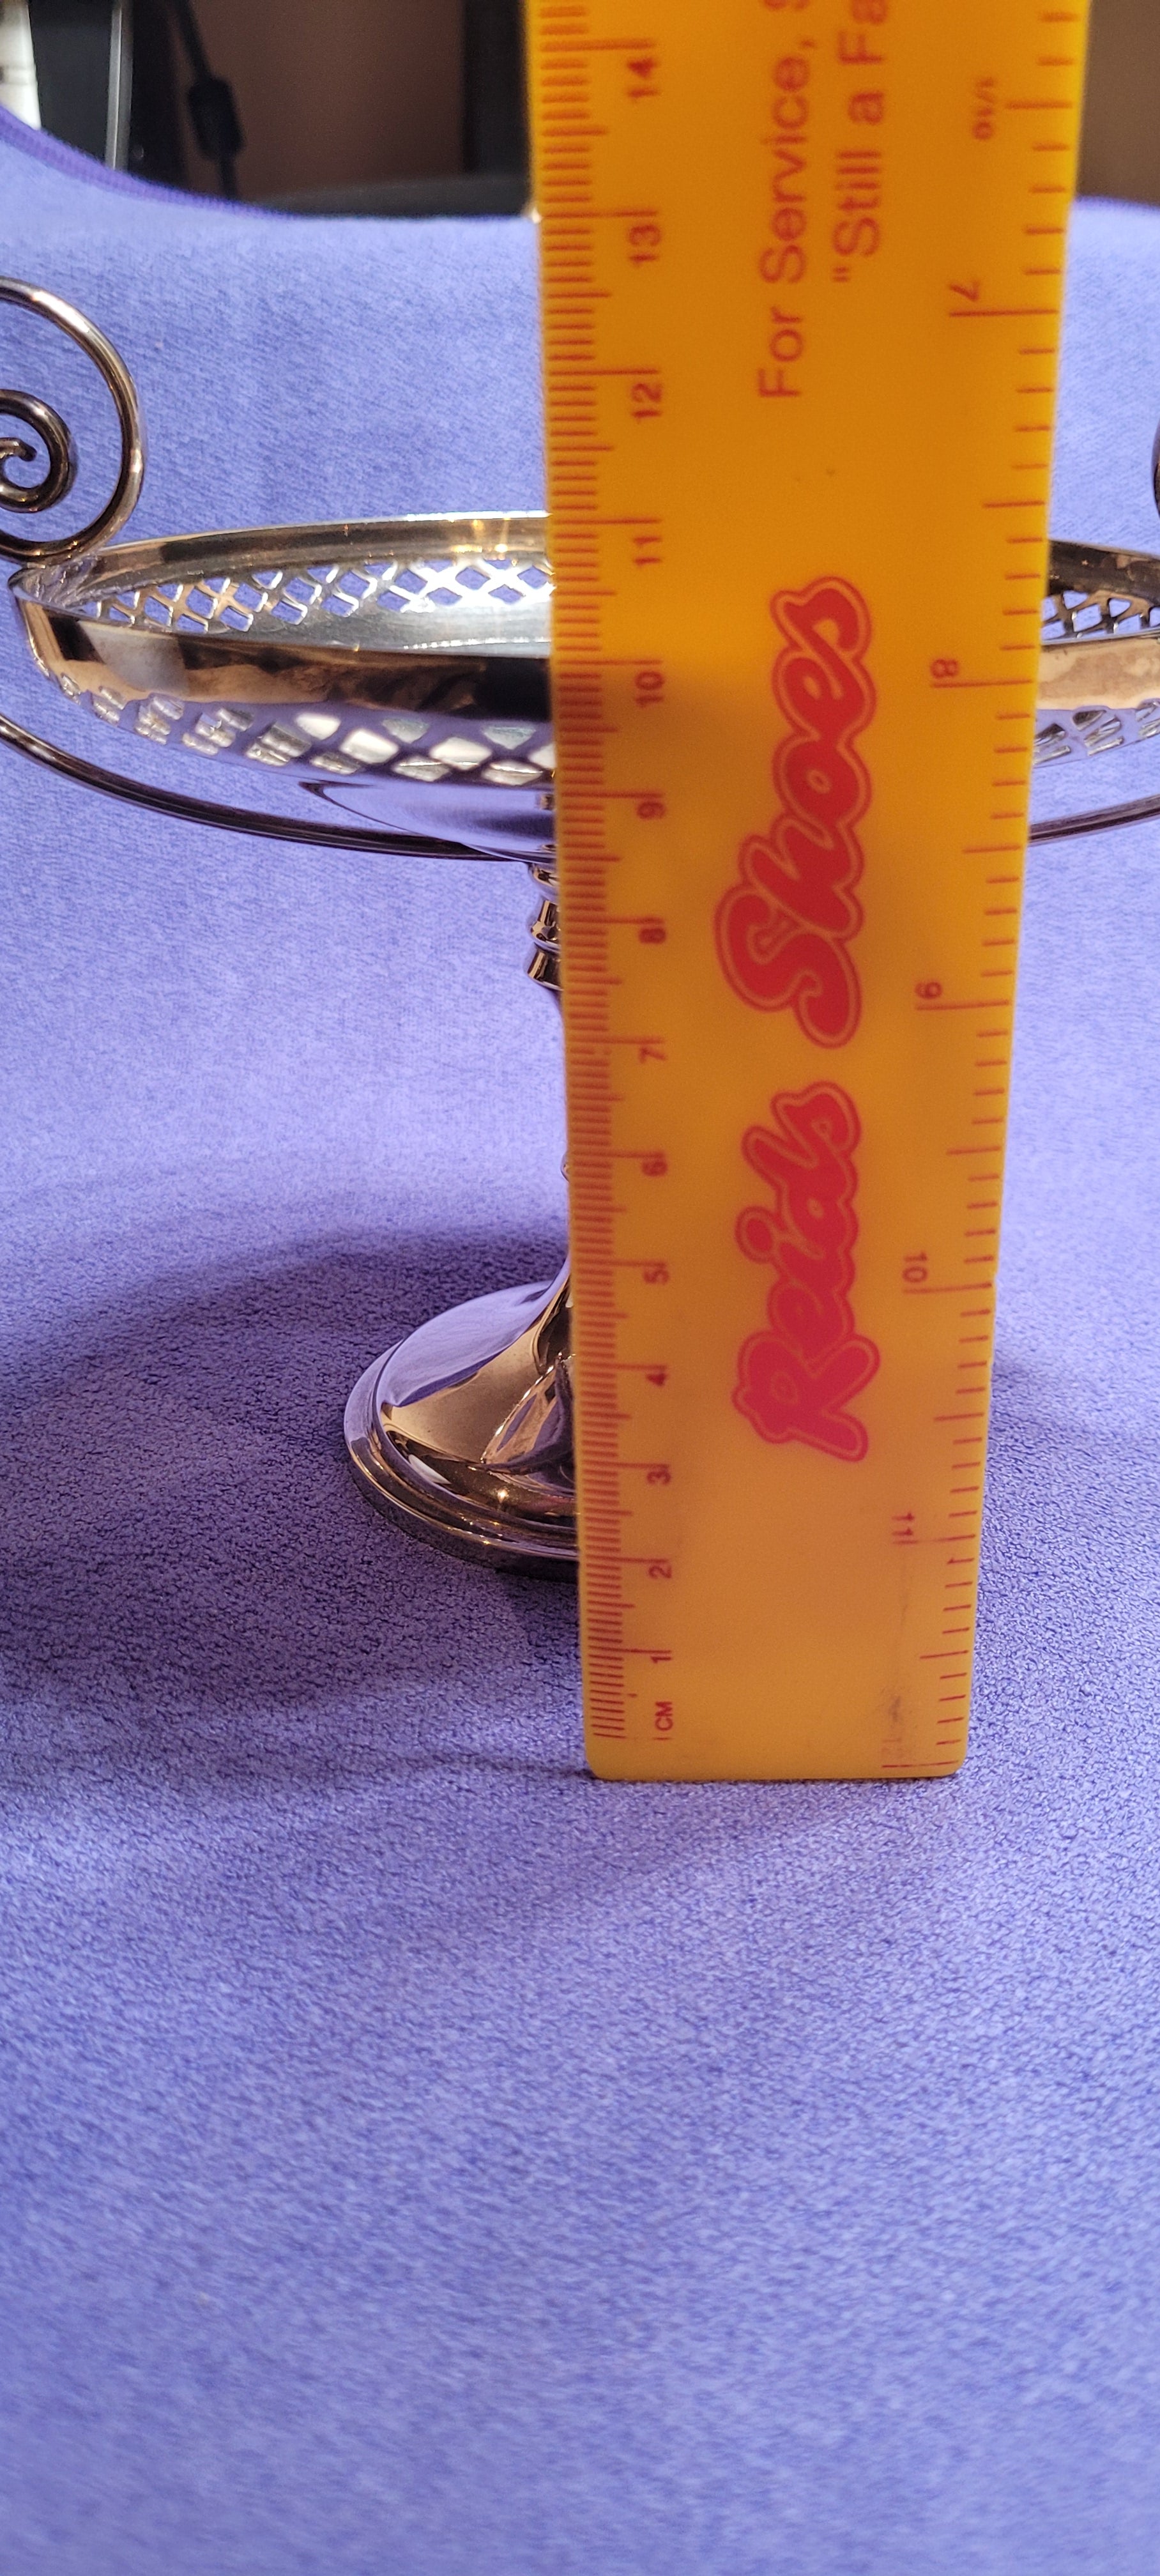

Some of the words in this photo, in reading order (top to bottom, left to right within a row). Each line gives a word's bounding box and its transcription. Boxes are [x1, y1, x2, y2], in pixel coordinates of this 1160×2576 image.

[627, 57, 659, 98] 14
[848, 91, 885, 126] a
[759, 39, 815, 284] Service,
[832, 151, 881, 283] "Still
[628, 223, 662, 263] 13
[949, 279, 980, 302] 7
[759, 307, 802, 399] For
[631, 383, 662, 418] 12
[632, 536, 662, 568] 11
[931, 658, 960, 678] 8
[635, 671, 665, 707] 10
[636, 801, 666, 820] 9
[714, 576, 877, 1049] Shoes
[639, 927, 666, 945] 8
[915, 981, 943, 999] 9
[639, 1048, 667, 1065] 7
[641, 1160, 668, 1177] 6
[643, 1267, 671, 1286] 5
[732, 1081, 880, 1462] Reids
[902, 1252, 929, 1284] 10
[646, 1370, 668, 1387] 4
[647, 1468, 672, 1485] 3
[894, 1512, 915, 1537] 11
[649, 1562, 673, 1580] 2
[655, 1701, 674, 1731] CM
